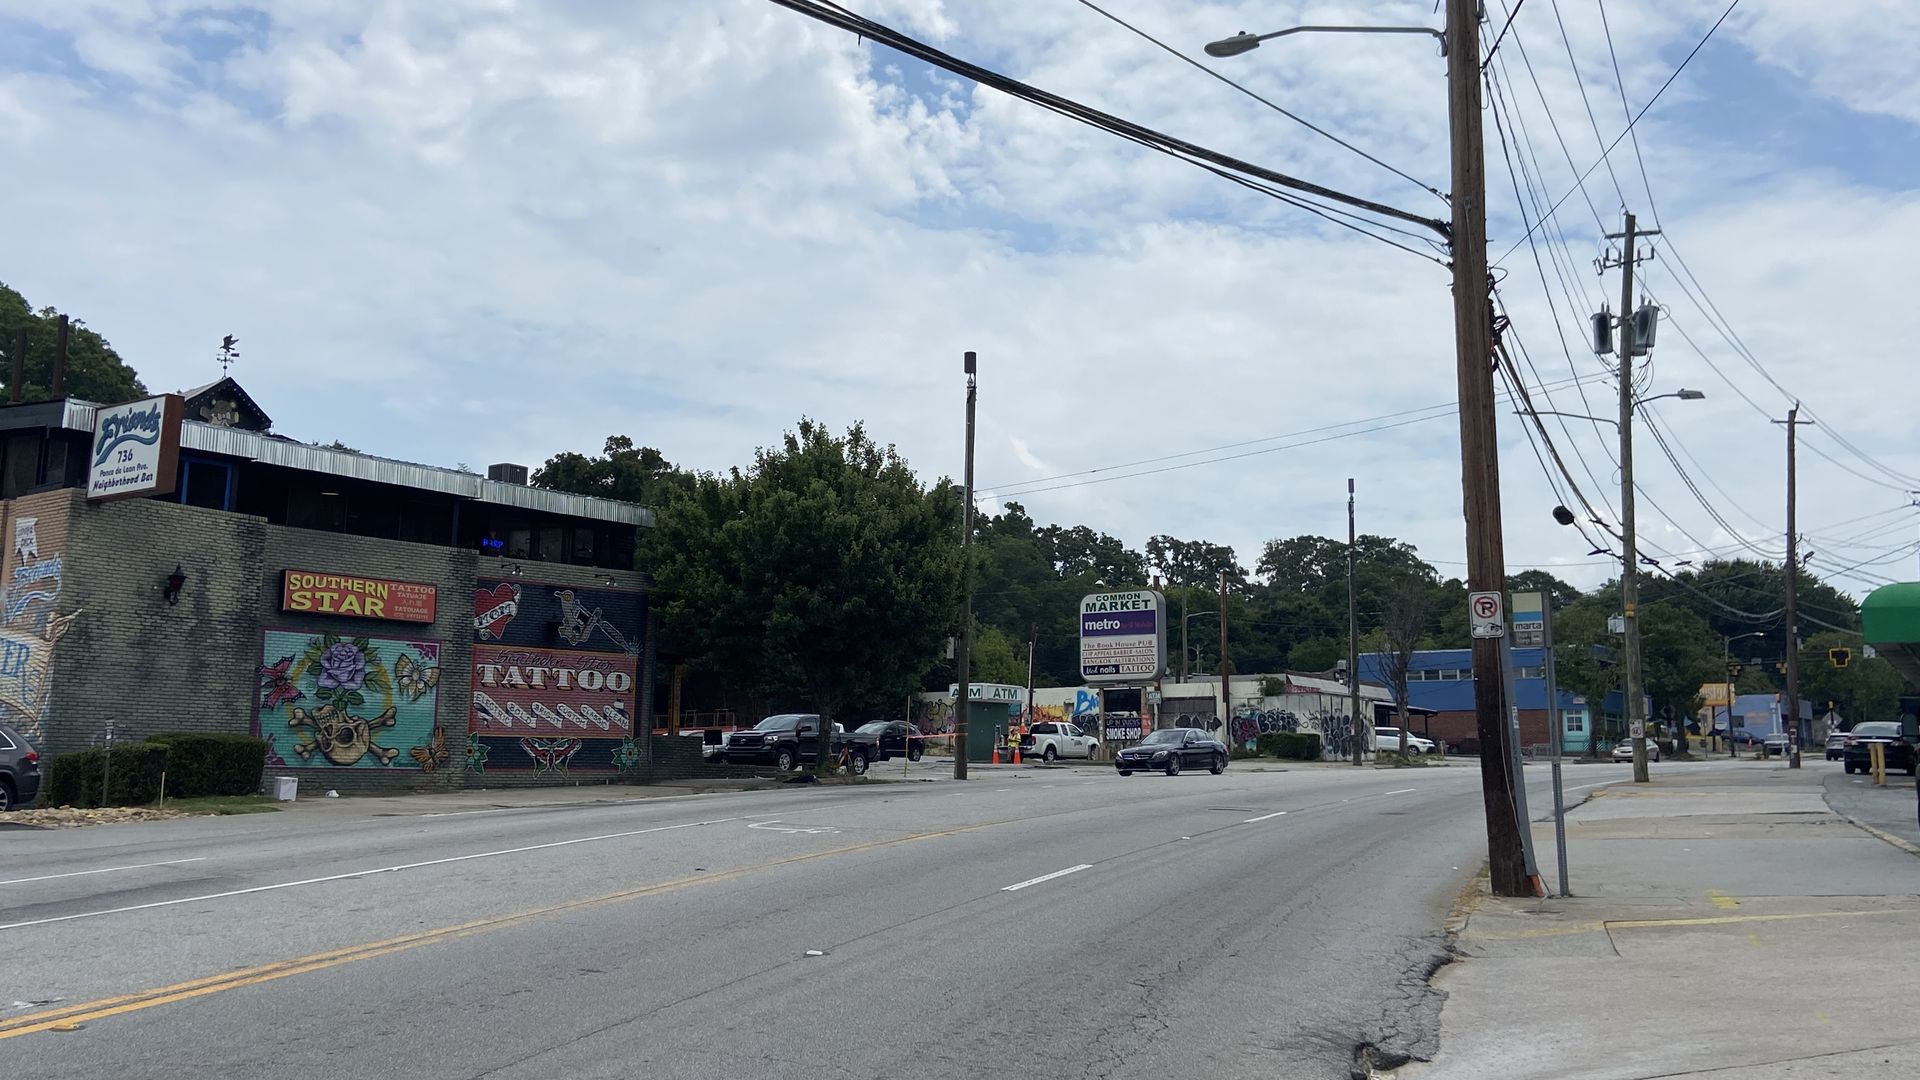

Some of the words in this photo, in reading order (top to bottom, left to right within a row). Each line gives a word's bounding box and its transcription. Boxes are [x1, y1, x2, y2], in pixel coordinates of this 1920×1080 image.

[96, 402, 161, 456] Friends
[117, 449, 133, 463] 736
[100, 469, 114, 477] Ponce
[115, 467, 122, 475] de
[123, 465, 135, 474] Leon
[137, 463, 149, 471] Ave.
[93, 475, 139, 491] Neighborhood
[141, 473, 153, 483] Bar
[289, 574, 388, 600] SOUTHERN
[390, 583, 436, 595] TATTOO
[397, 592, 427, 600] TATUAJE
[1096, 593, 1141, 602] COMMON
[290, 591, 385, 617] STAR
[394, 606, 428, 614] TATOUAGE
[1085, 600, 1151, 612] MARKET
[1085, 619, 1120, 630] metro
[1114, 656, 1155, 664] ALTERATIONS
[1121, 664, 1155, 672] TATTOO
[477, 664, 632, 692] TATTOO
[952, 688, 981, 698] AM
[993, 688, 1018, 699] ATM
[509, 703, 532, 725] BOLD
[558, 705, 587, 727] CUSTOM
[604, 706, 628, 728] CLEAN
[1106, 727, 1126, 740] SMOKE
[1126, 727, 1141, 740] SHOP
